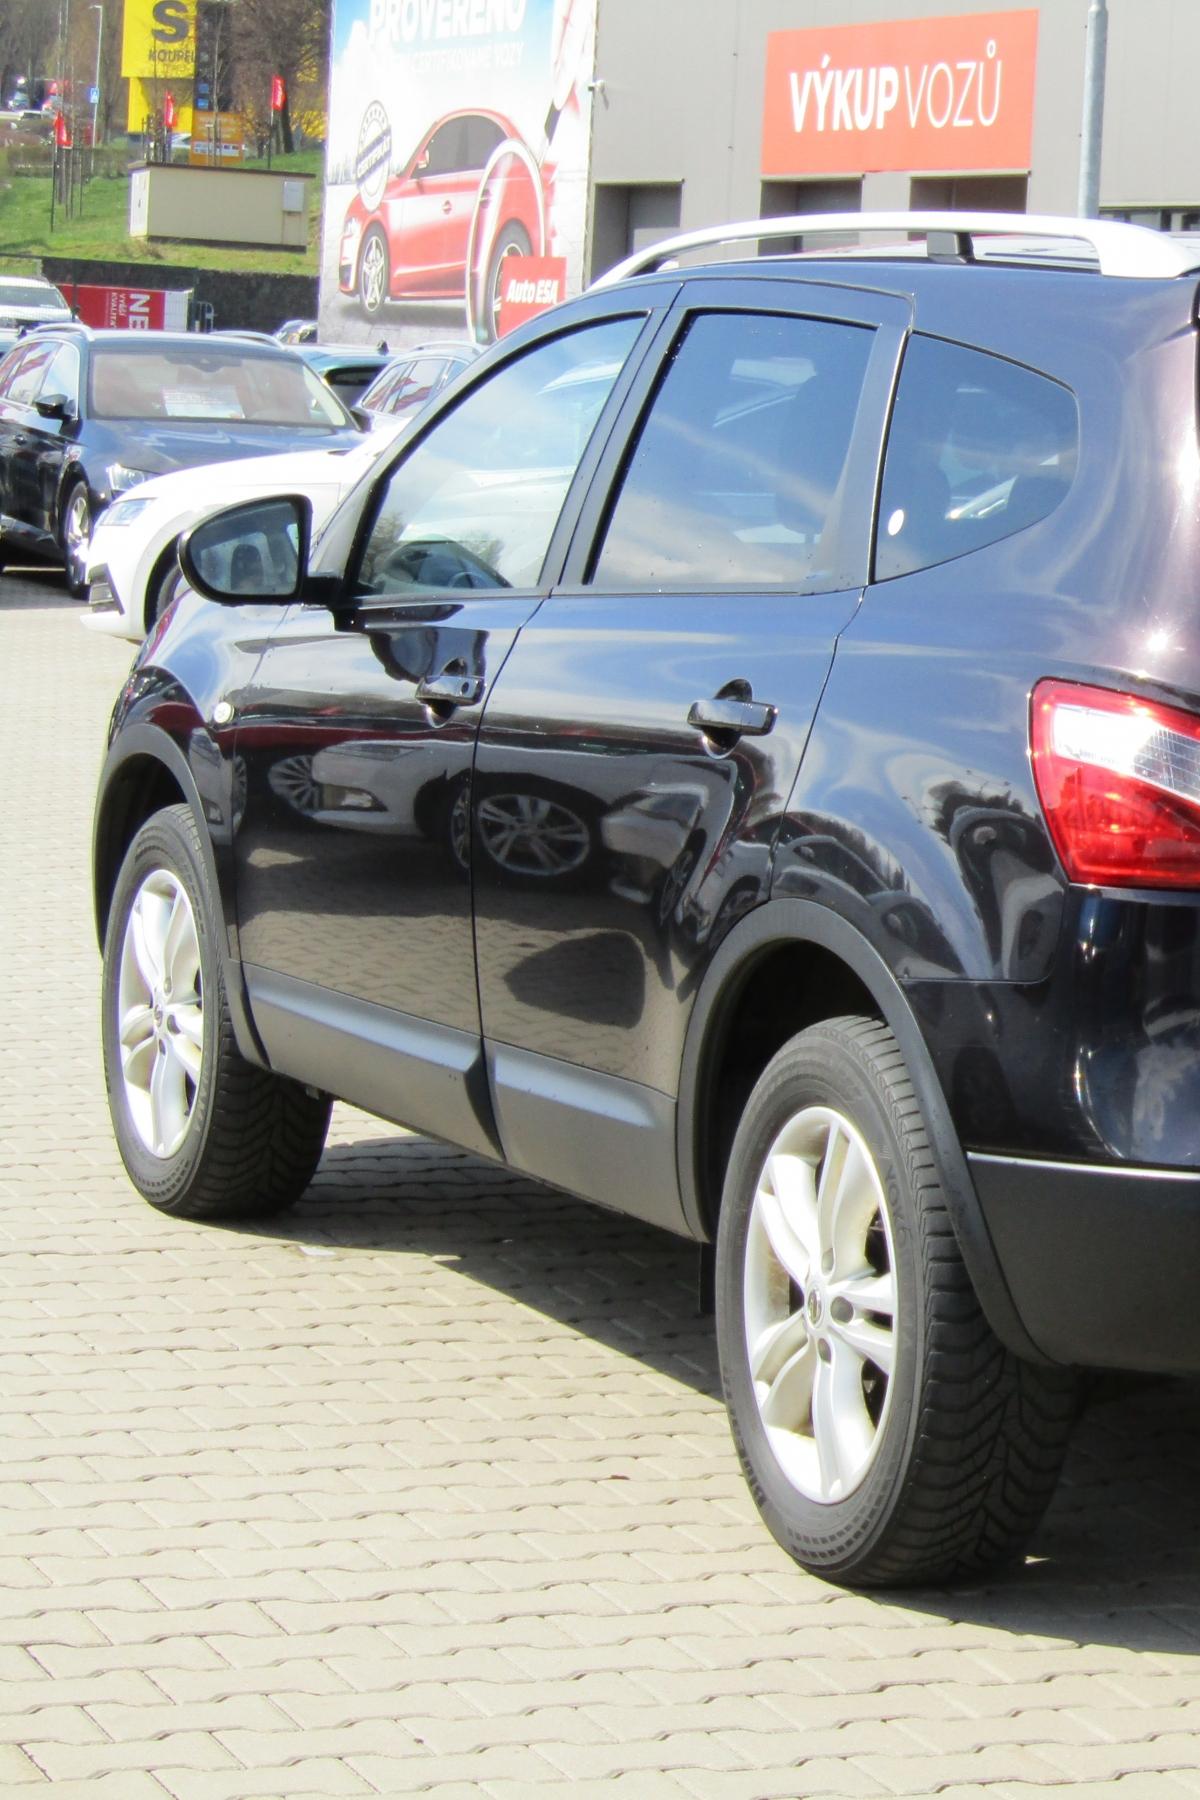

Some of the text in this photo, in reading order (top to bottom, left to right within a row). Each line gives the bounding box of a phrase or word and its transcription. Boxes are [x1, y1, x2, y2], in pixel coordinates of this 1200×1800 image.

[789, 39, 1002, 133] VÝKUP VOZŮ
[505, 279, 559, 305] Auto ESA
